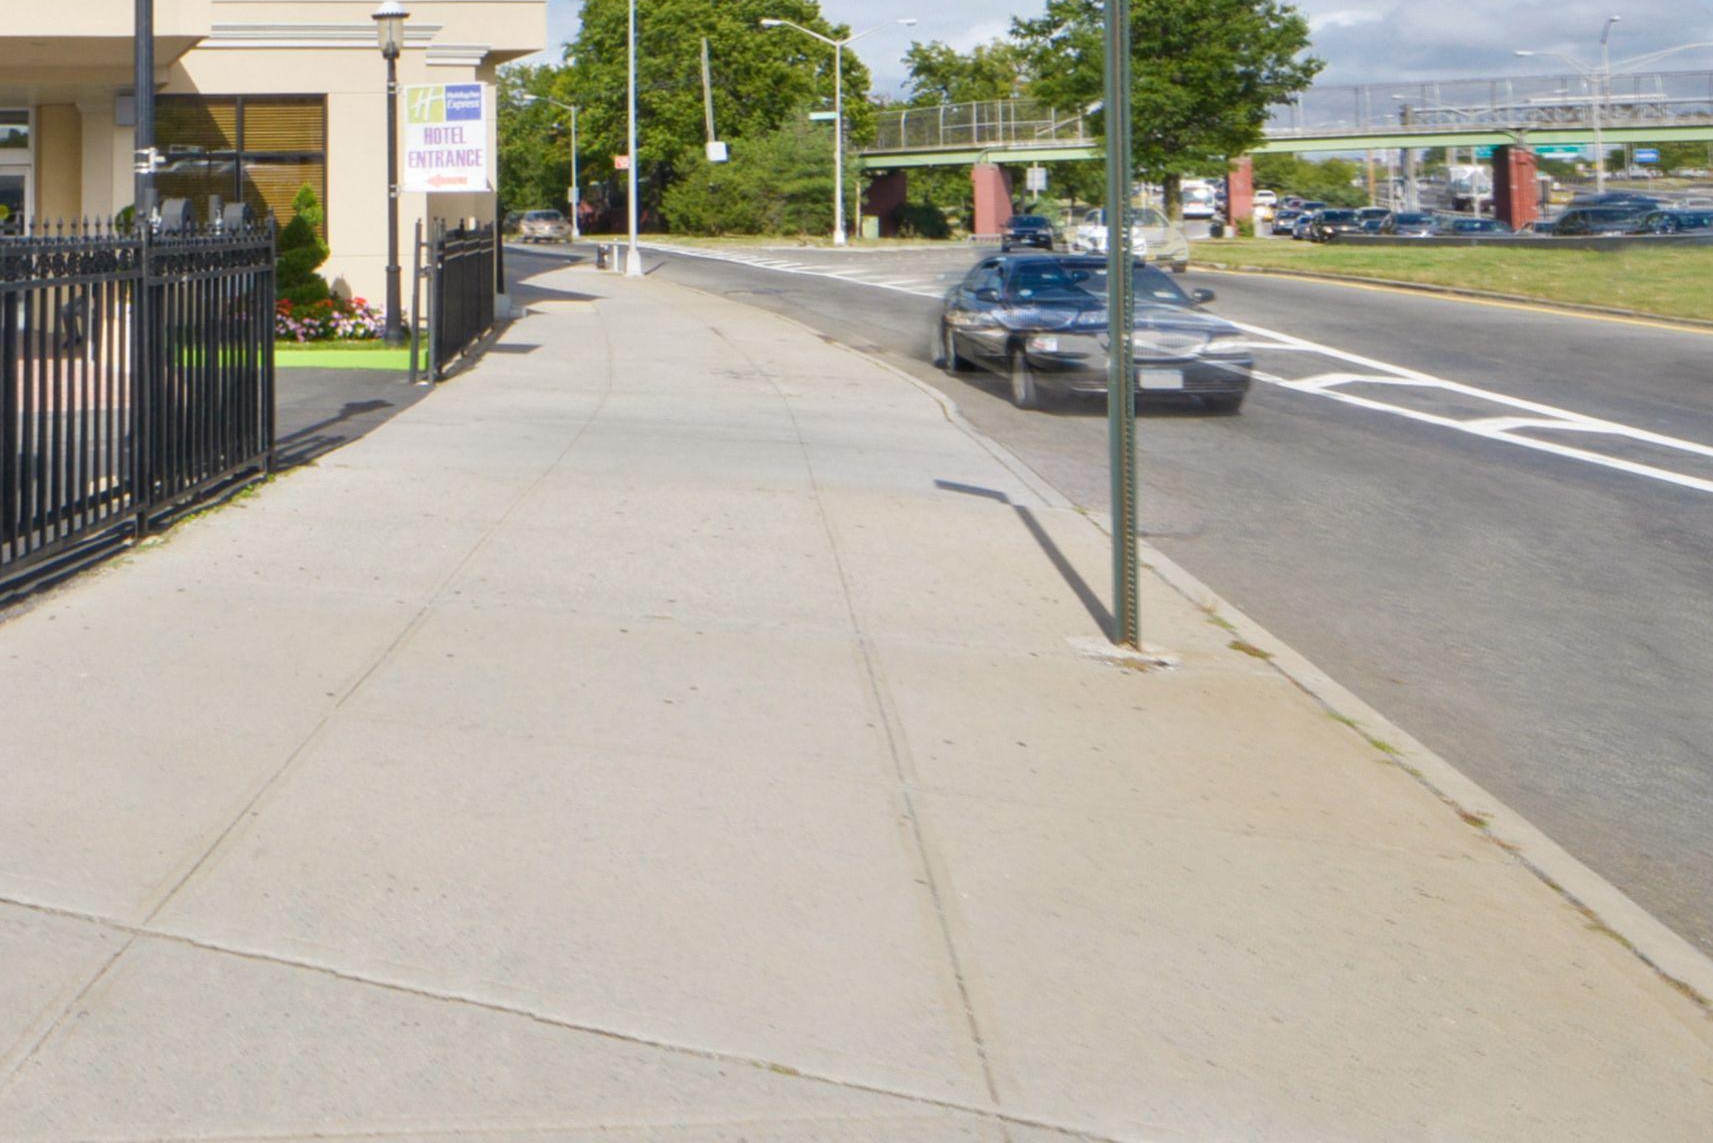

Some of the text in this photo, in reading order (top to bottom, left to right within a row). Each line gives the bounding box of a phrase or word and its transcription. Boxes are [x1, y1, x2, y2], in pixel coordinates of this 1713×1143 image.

[447, 99, 480, 110] Express
[424, 126, 466, 145] HOTEL
[408, 149, 483, 169] ENTRANCE
